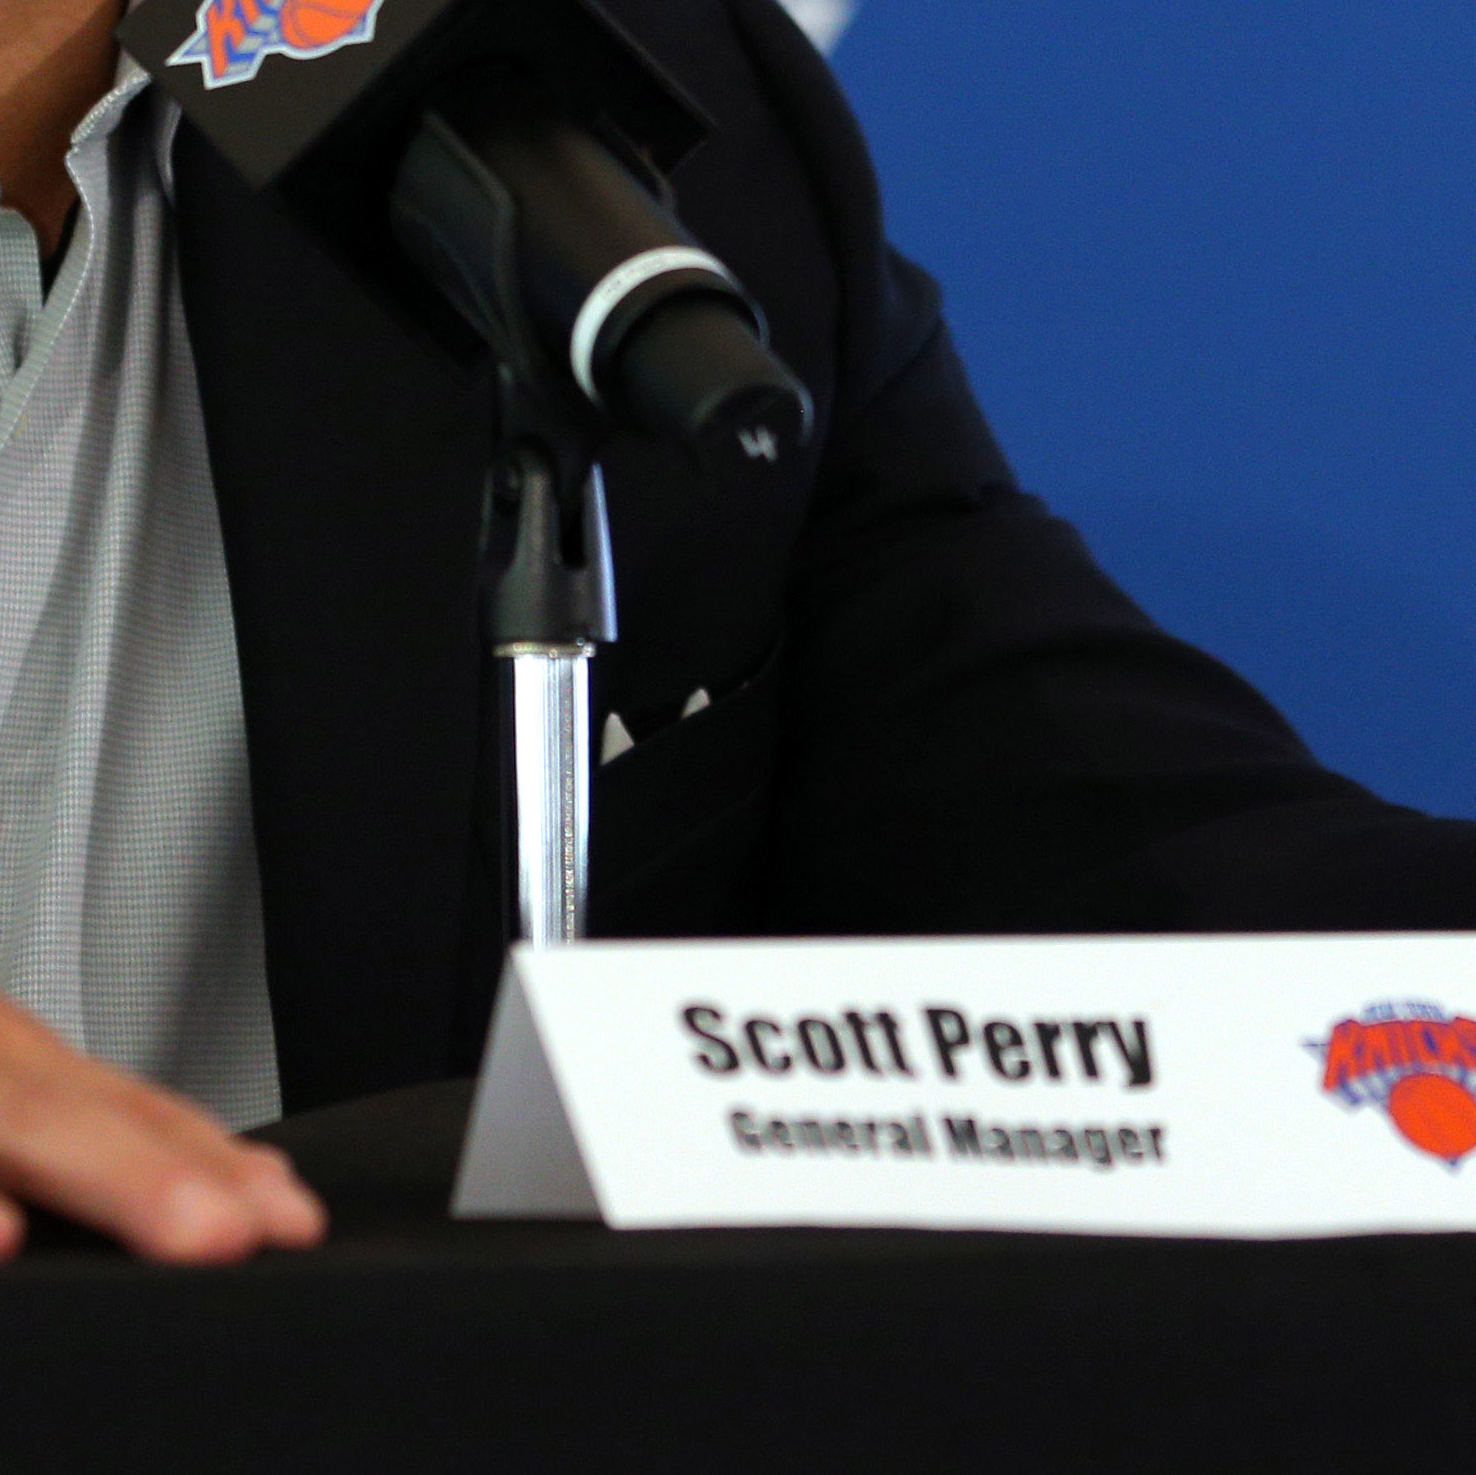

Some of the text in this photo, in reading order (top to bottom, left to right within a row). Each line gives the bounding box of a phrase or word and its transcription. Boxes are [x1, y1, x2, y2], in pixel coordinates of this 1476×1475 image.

[681, 1005, 1154, 1088] Scott Perry
[729, 1110, 1165, 1168] General Manager
